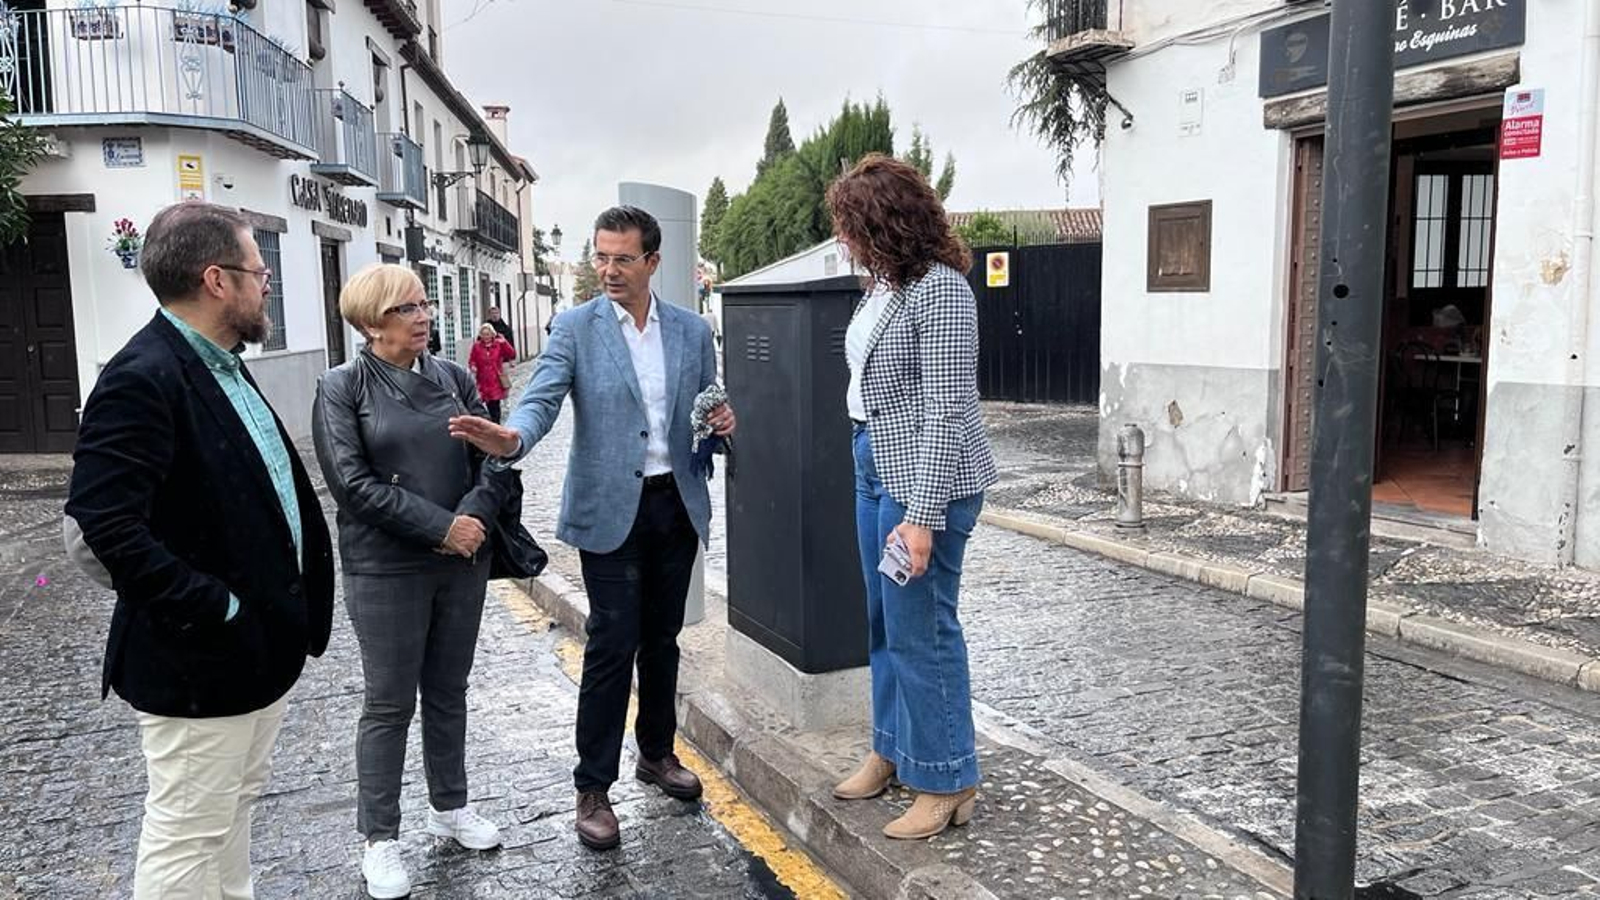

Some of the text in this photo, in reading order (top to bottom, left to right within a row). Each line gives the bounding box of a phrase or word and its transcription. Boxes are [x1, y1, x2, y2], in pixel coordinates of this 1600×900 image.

[1409, 24, 1477, 51] Esquinas
[1505, 119, 1540, 130] Alarma
[291, 174, 321, 212] CASA
